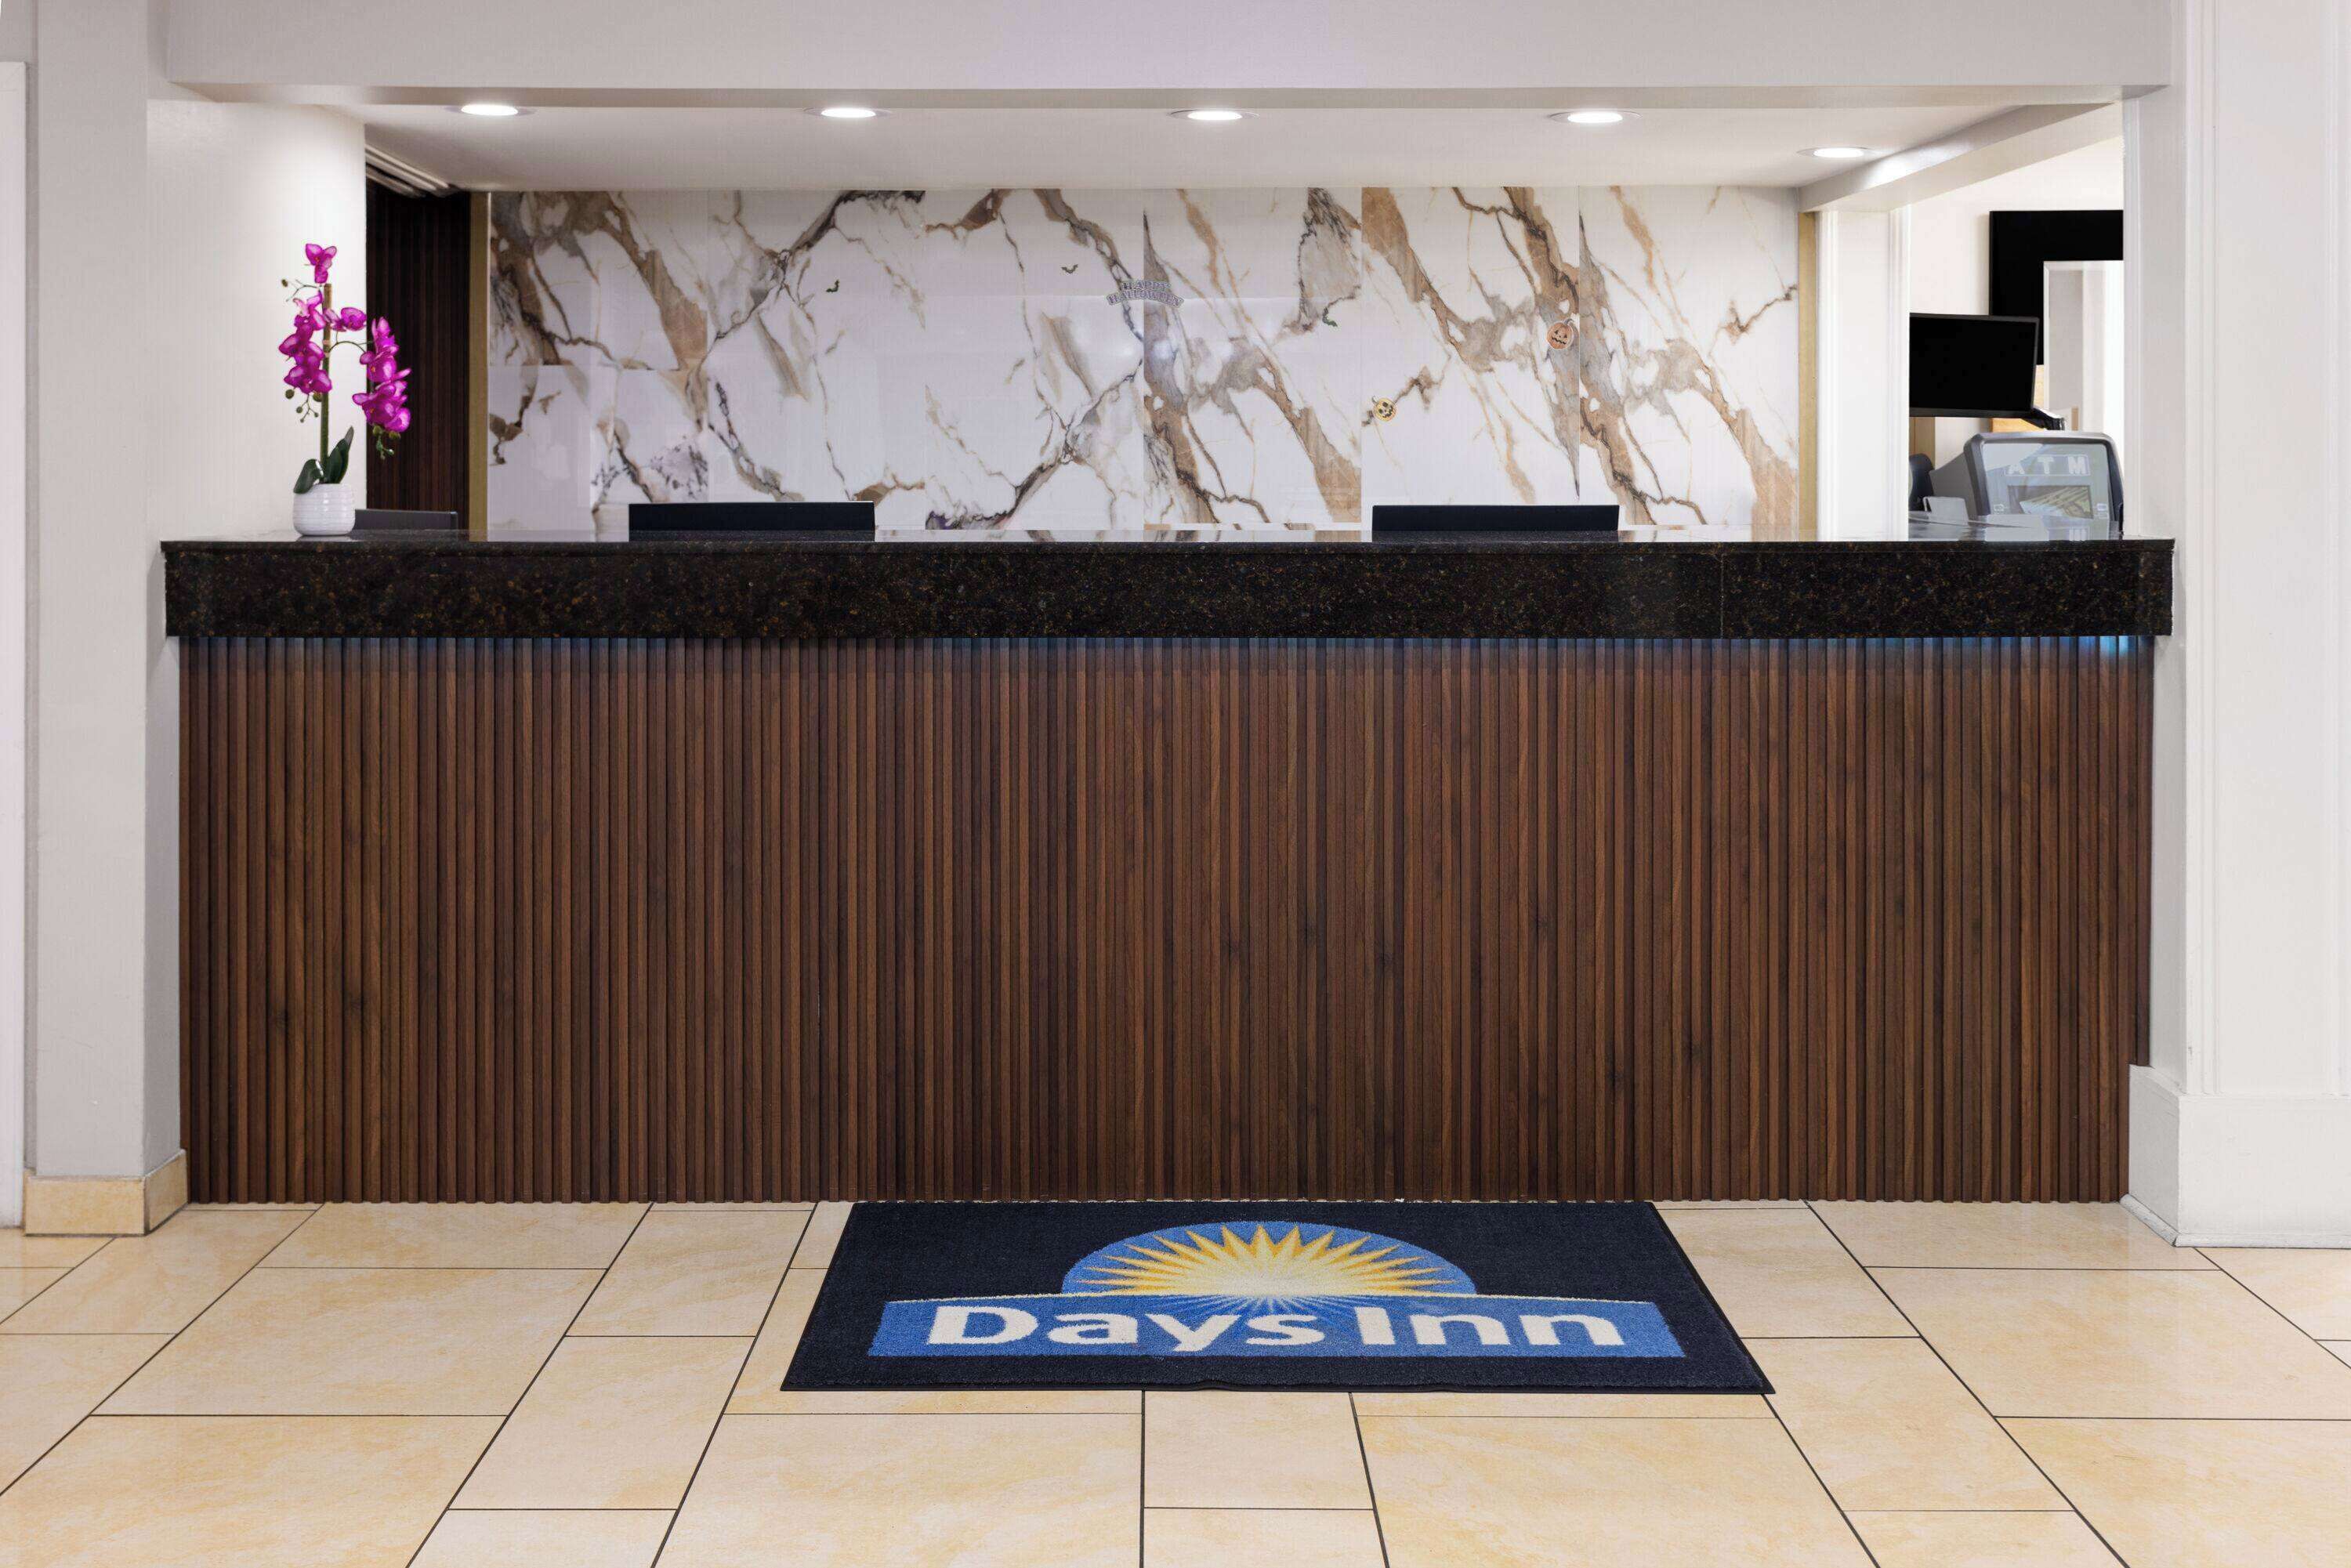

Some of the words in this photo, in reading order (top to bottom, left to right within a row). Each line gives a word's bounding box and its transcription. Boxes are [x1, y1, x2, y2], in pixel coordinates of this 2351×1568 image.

[2007, 456, 2087, 475] ATM
[926, 1305, 1326, 1352] Days
[1354, 1306, 1625, 1346] Inn
